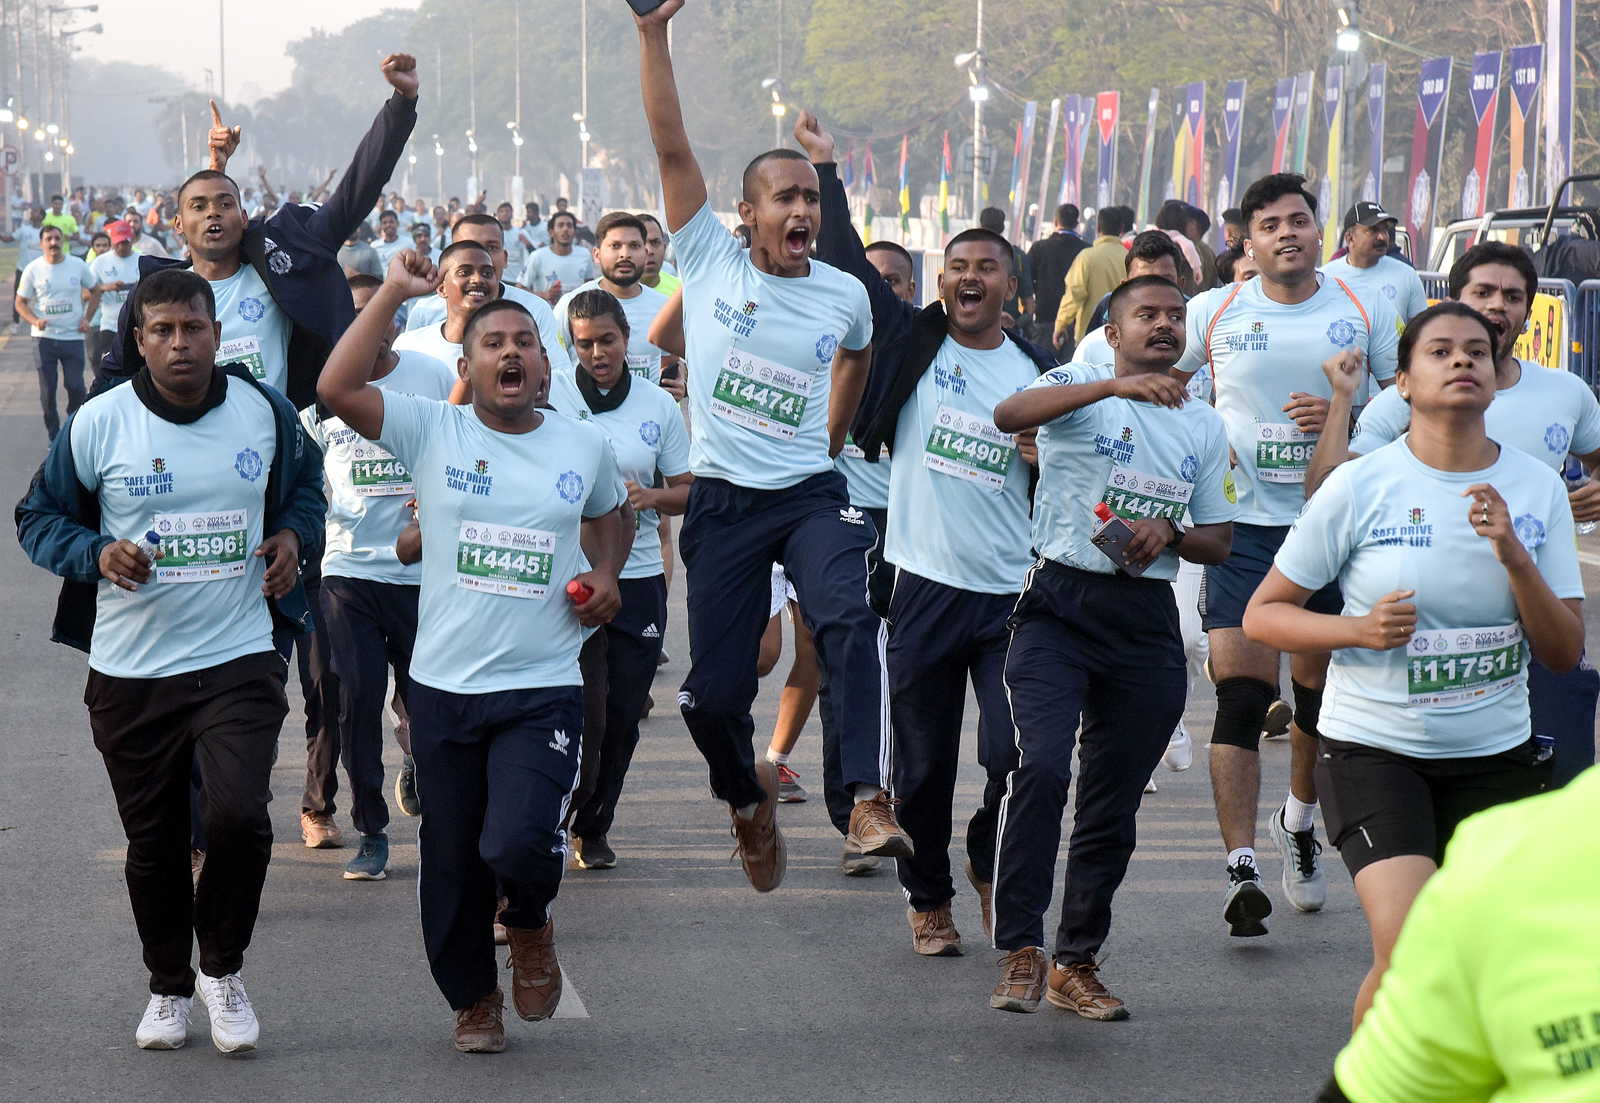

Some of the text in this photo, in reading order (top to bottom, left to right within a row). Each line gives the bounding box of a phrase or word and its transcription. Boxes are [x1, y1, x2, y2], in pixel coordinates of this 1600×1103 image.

[714, 297, 758, 329] SAFE DRIVE
[713, 309, 753, 338] SAVE LIFE
[1225, 333, 1268, 344] SAFE DRIVE
[1230, 342, 1268, 351] SAVE LIFE
[730, 378, 795, 415] 14474
[941, 432, 1001, 464] 14490
[1094, 433, 1136, 455] SAFE DRIVE
[1095, 444, 1133, 464] SAVE LIFE
[1268, 444, 1315, 461] 1498
[124, 472, 174, 487] SAFE DRIVE
[362, 461, 409, 478] 1446
[445, 465, 494, 487] SAFE DRIVE
[128, 483, 174, 497] SAVE LIFE
[446, 477, 491, 497] SAVE LIFE
[1114, 492, 1174, 519] 14471
[840, 516, 865, 525] adidas
[1400, 525, 1433, 537] DRIVE
[168, 535, 237, 558] 13596
[1410, 536, 1433, 547] LIFE
[470, 547, 540, 575] 14445
[1424, 650, 1508, 682] 11751
